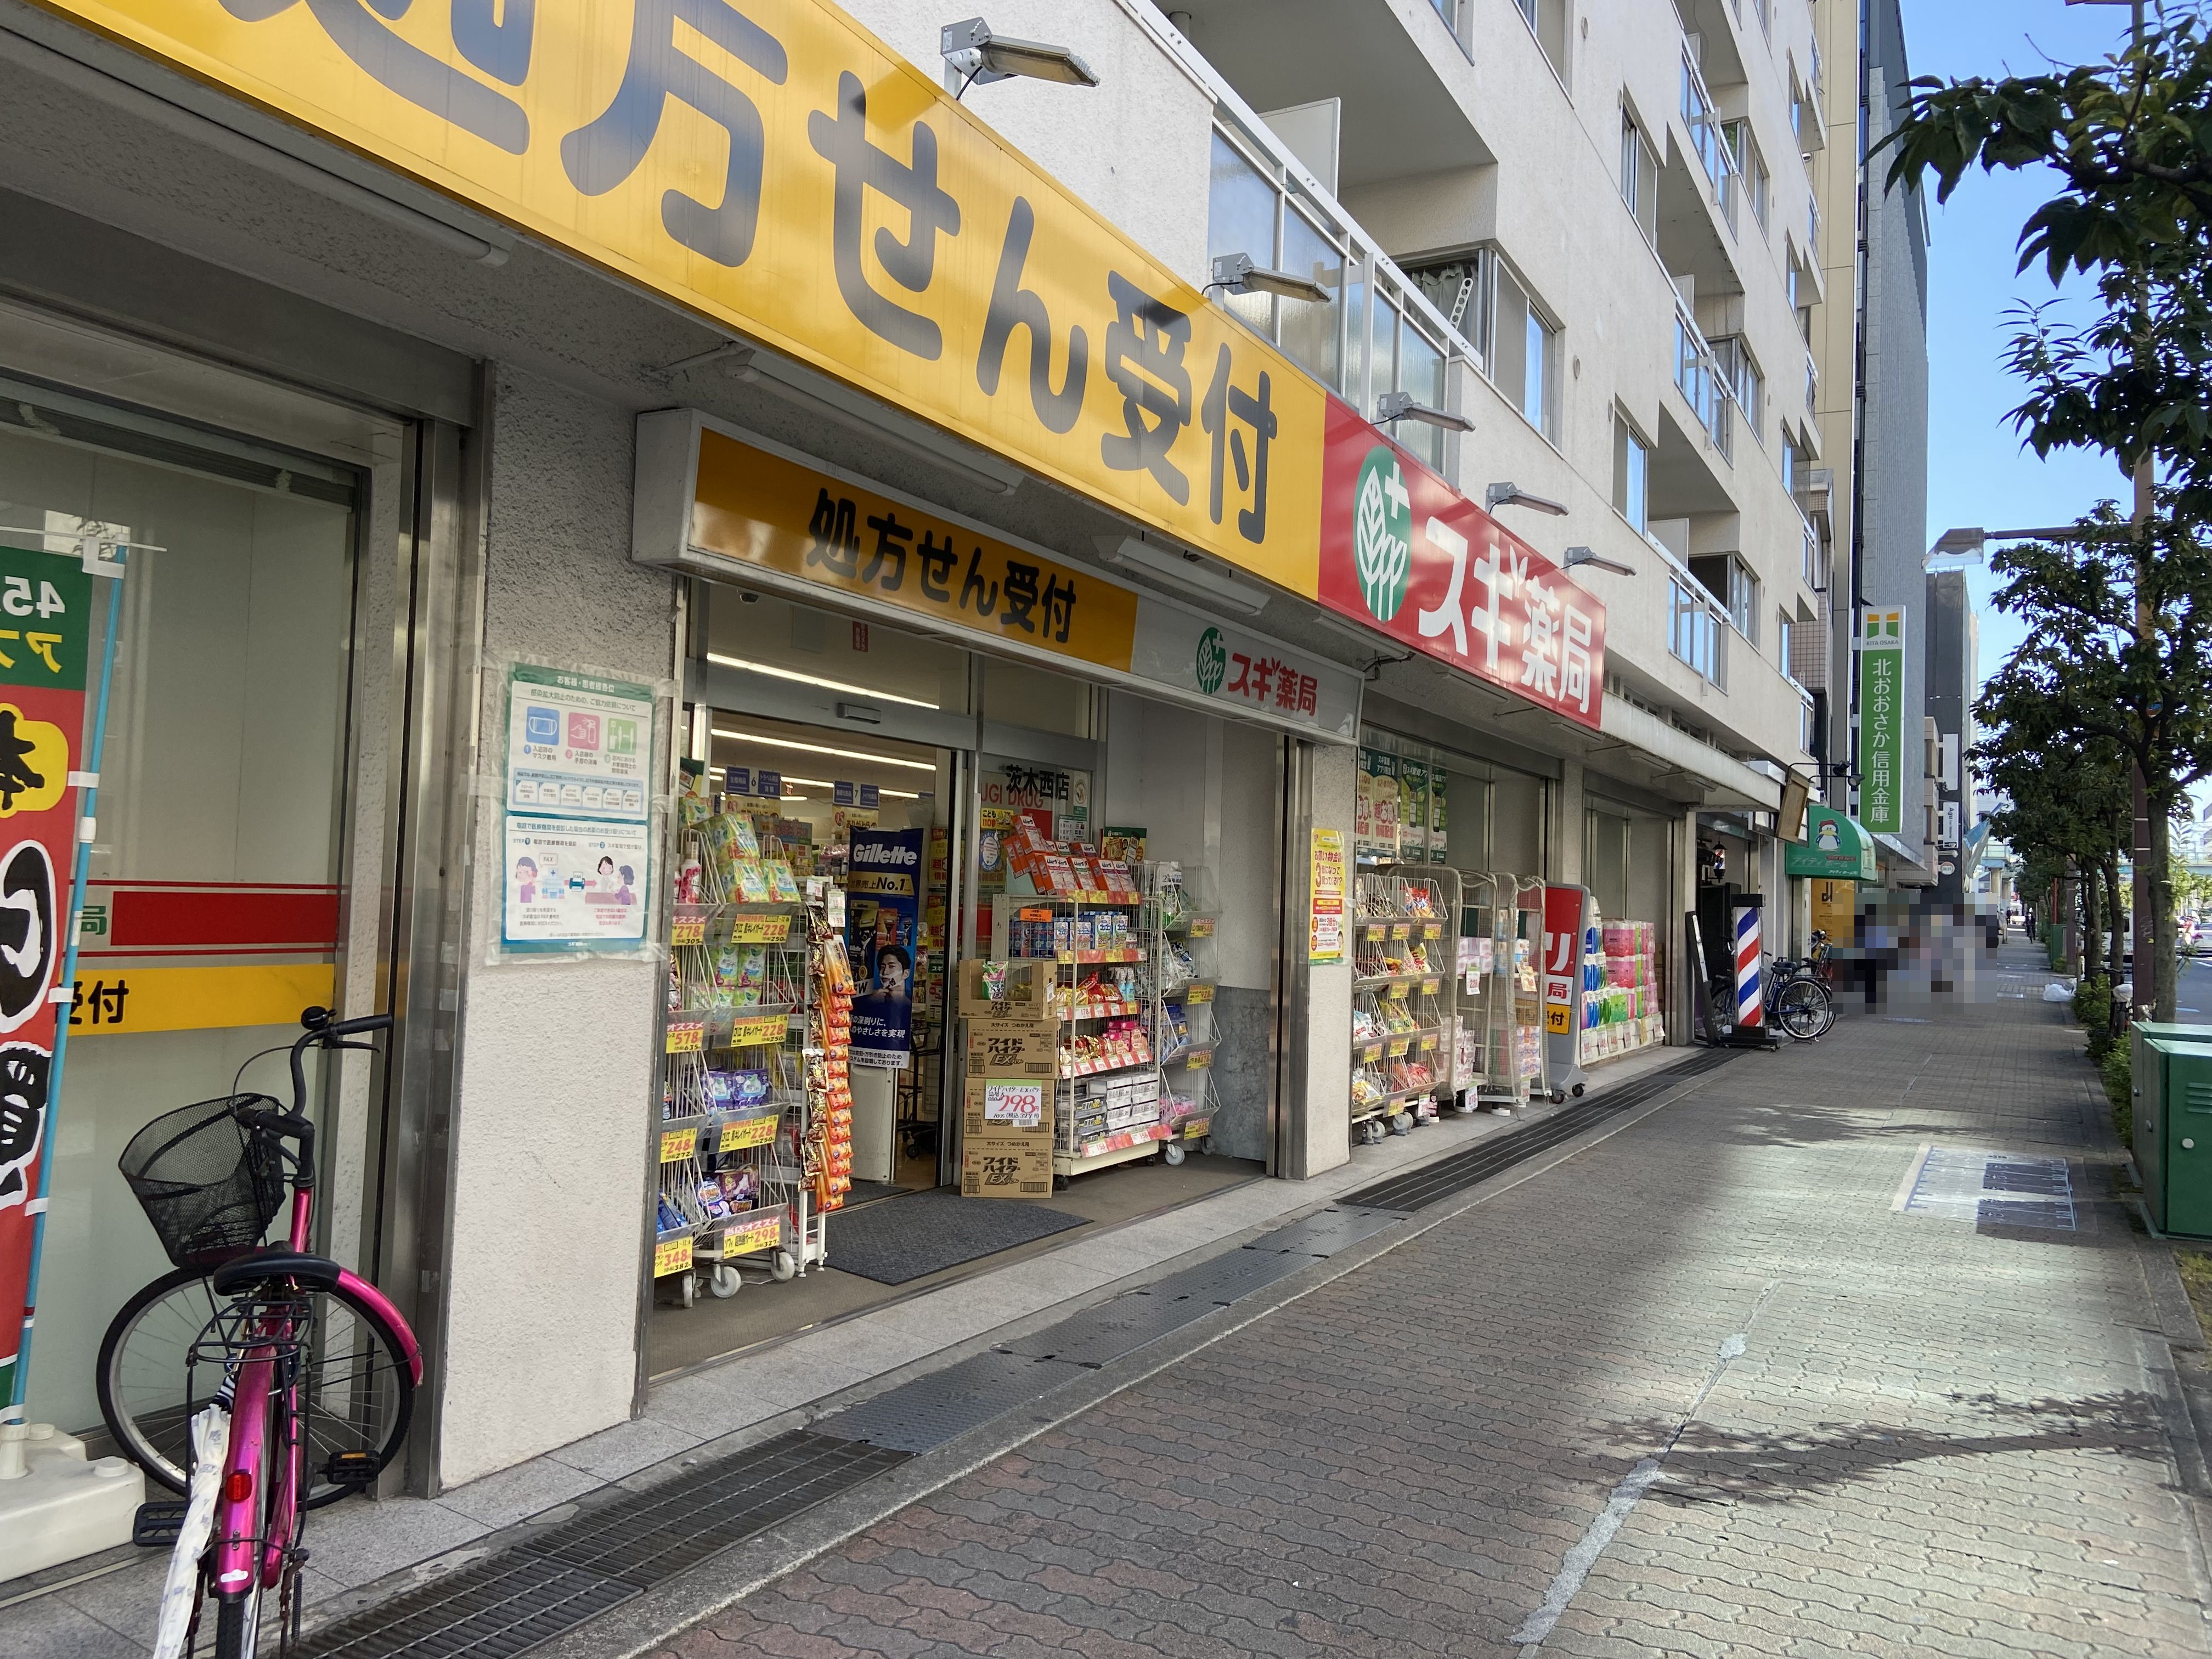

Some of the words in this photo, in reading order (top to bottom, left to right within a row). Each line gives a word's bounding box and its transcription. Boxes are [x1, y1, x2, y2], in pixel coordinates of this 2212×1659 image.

[806, 487, 1077, 645] 処方せん受付
[1418, 515, 1593, 715] スギ薬局
[1227, 652, 1317, 718] スギ薬局
[1870, 658, 1892, 823] 北おおさか信用金庫
[751, 777, 757, 787] 6
[1006, 764, 1070, 801] 茨木西店
[854, 789, 859, 798] 7
[853, 843, 917, 866] Gillette
[81, 905, 107, 935] 局
[1547, 982, 1567, 1000] 局
[1547, 1010, 1565, 1026] 付
[987, 1037, 1023, 1046] ワイド
[987, 1046, 1025, 1054] ハイター
[983, 1156, 1019, 1165] ワイド
[983, 1164, 1021, 1173] ハイター
[724, 1215, 780, 1235] 当店オススメ
